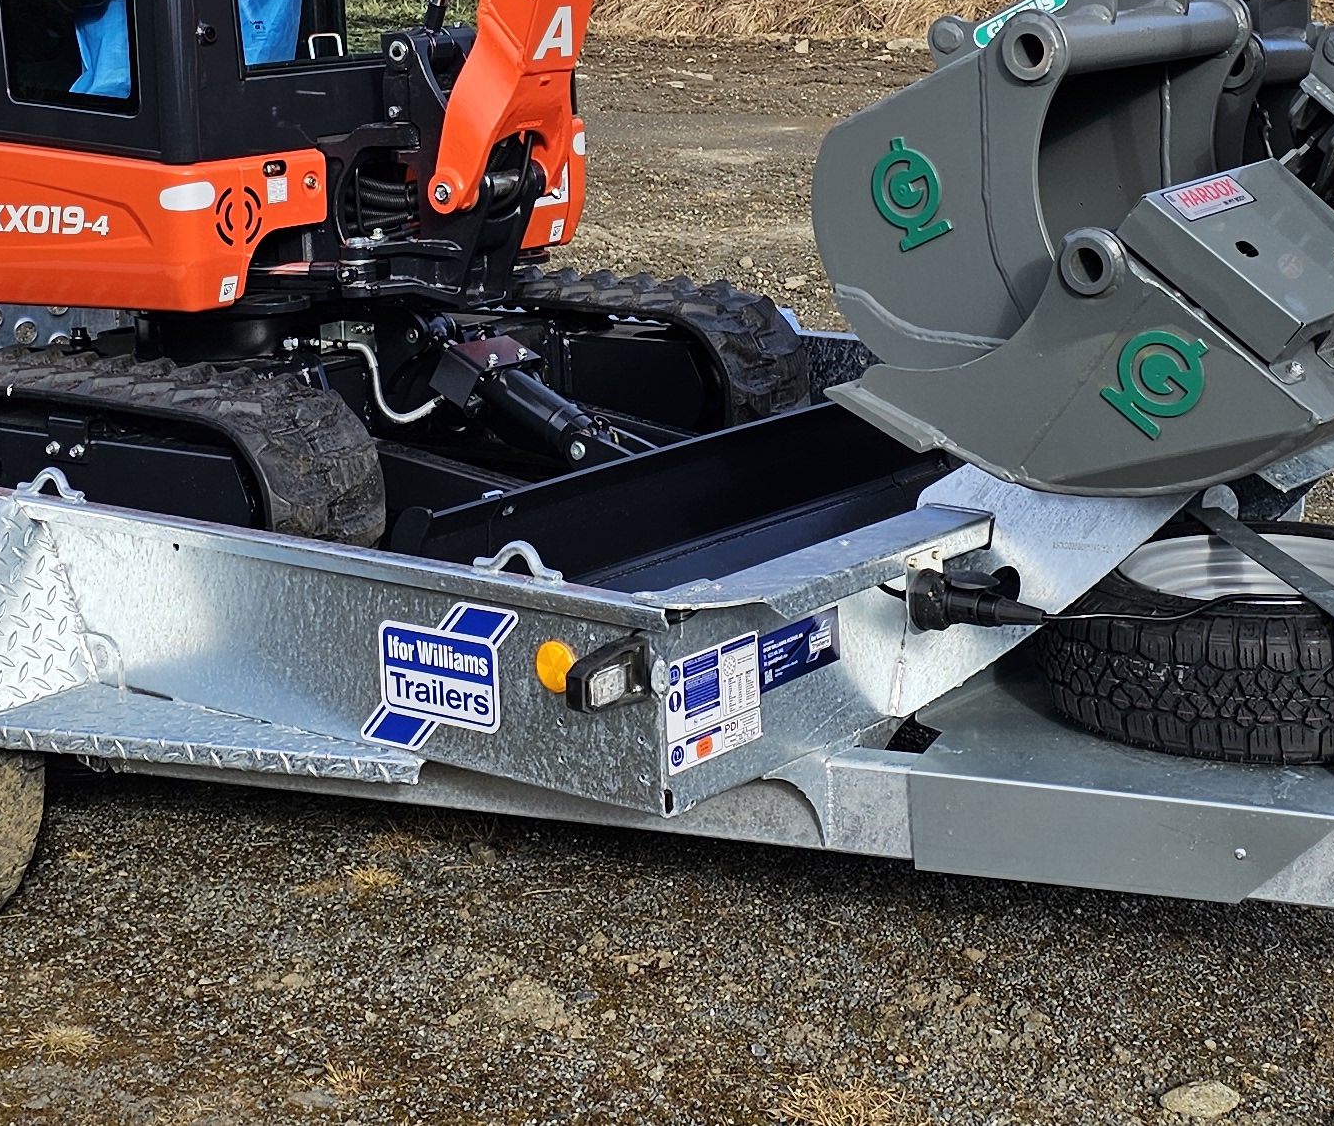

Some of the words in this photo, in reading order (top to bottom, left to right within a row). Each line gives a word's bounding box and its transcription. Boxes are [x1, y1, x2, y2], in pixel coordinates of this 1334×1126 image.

[1177, 179, 1239, 208] HARDOX
[387, 635, 414, 661] Ifor
[416, 639, 489, 676] Williams
[390, 671, 489, 715] Trailers
